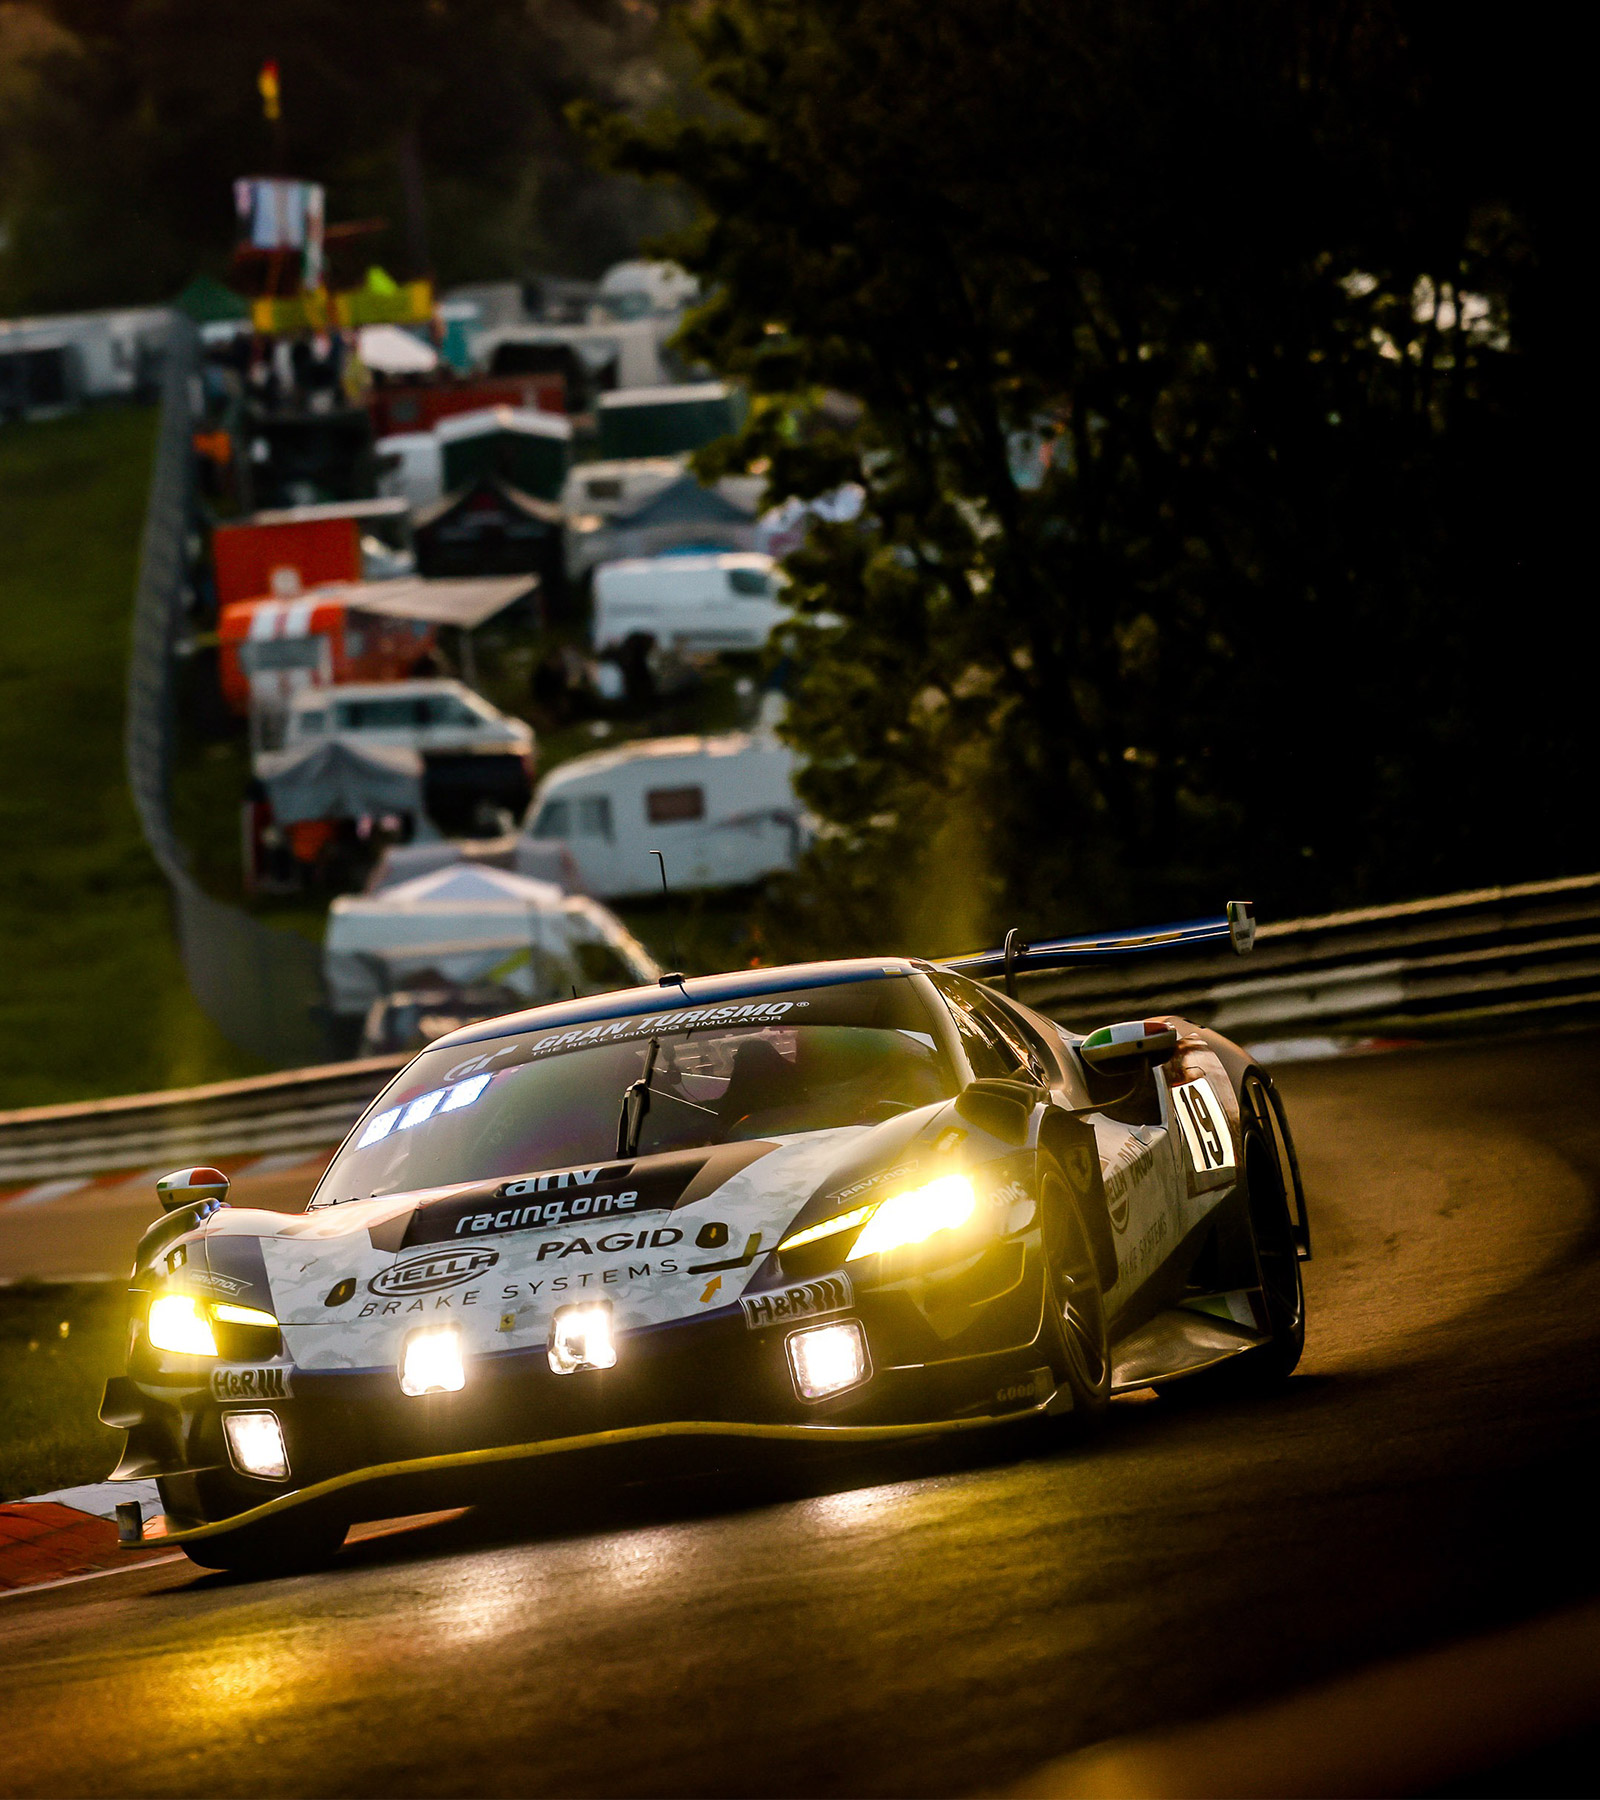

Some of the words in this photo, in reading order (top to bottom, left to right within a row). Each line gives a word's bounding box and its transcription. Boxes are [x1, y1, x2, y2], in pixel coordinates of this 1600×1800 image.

[531, 1020, 632, 1051] GRAN
[532, 1045, 562, 1057] THE
[567, 1037, 609, 1049] REAL
[613, 1026, 680, 1040] DRIVING
[684, 1015, 783, 1029] SIMULATOR
[1179, 1085, 1224, 1169] 19
[536, 1228, 684, 1262] PAGID
[380, 1252, 500, 1287] HELLA
[358, 1290, 480, 1318] BRAKE
[501, 1259, 679, 1300] SYSTEMS
[749, 1289, 811, 1326] H&R
[214, 1371, 258, 1396] H&R
